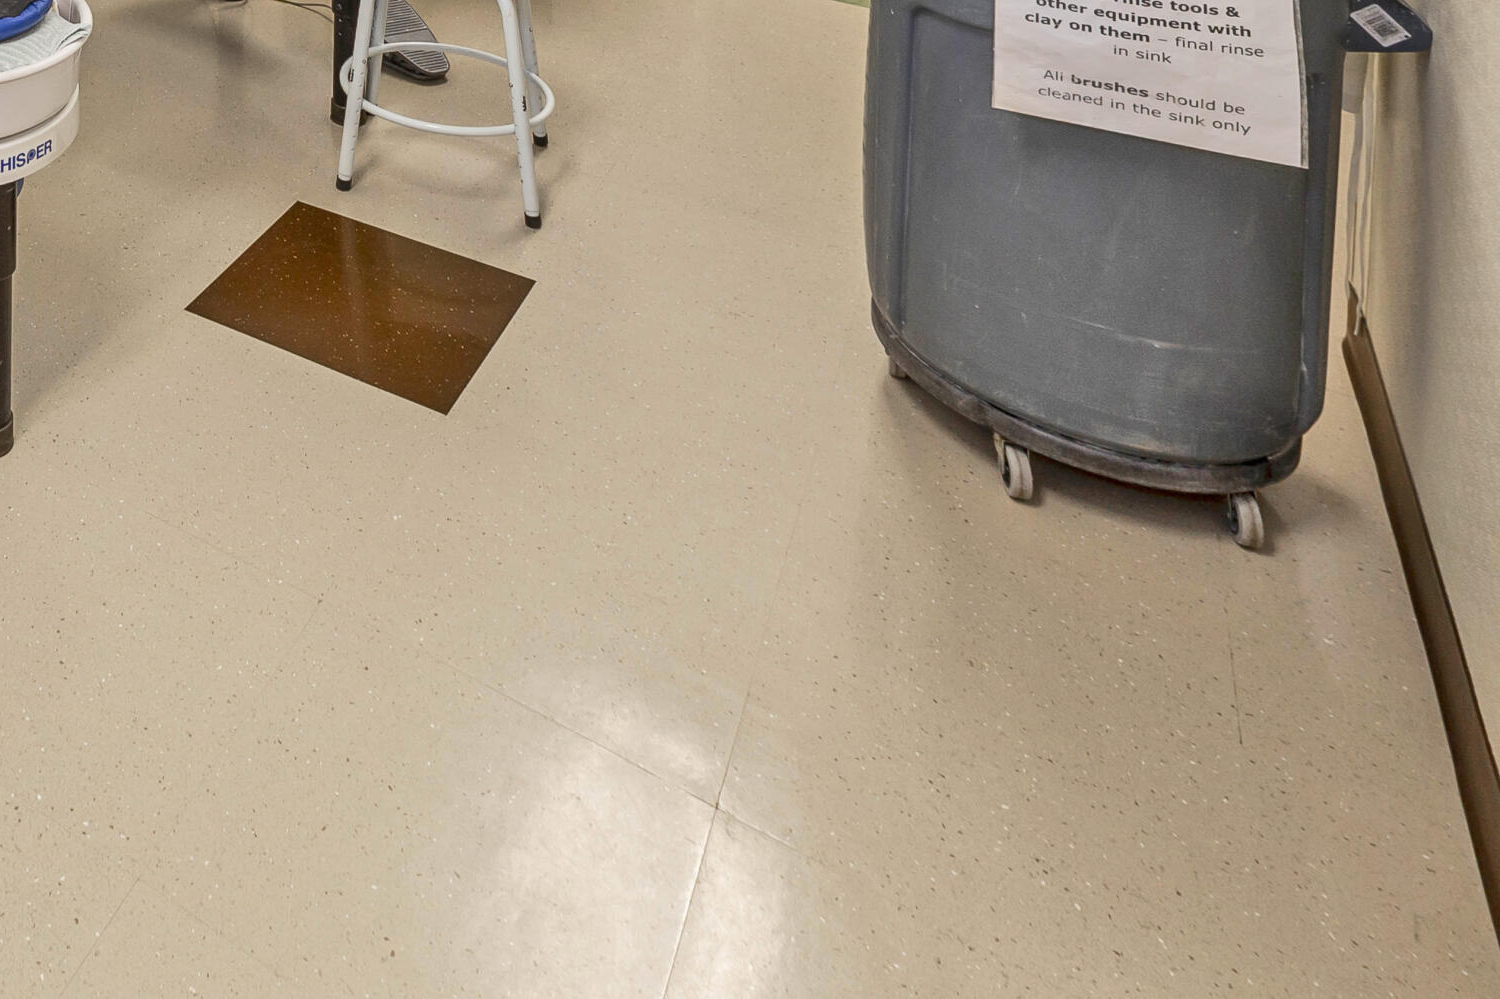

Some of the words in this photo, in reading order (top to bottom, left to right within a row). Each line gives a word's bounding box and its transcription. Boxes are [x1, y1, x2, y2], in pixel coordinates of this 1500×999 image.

[1094, 6, 1201, 32] equipment
[1208, 23, 1251, 38] with
[1170, 0, 1219, 16] tools
[1226, 6, 1240, 18] &
[1025, 12, 1062, 29] clay
[1069, 22, 1092, 33] on
[1100, 25, 1150, 43] them
[1175, 37, 1213, 51] final
[1221, 44, 1264, 58] rinse
[1114, 45, 1128, 56] in
[1136, 49, 1172, 64] sink
[1038, 87, 1103, 106] cleaned
[1111, 99, 1125, 110] in
[1133, 103, 1161, 118] the
[1169, 112, 1205, 127] sink
[1212, 120, 1251, 136] only
[1071, 75, 1149, 98] brushes
[1156, 91, 1216, 111] should
[1224, 102, 1245, 115] be
